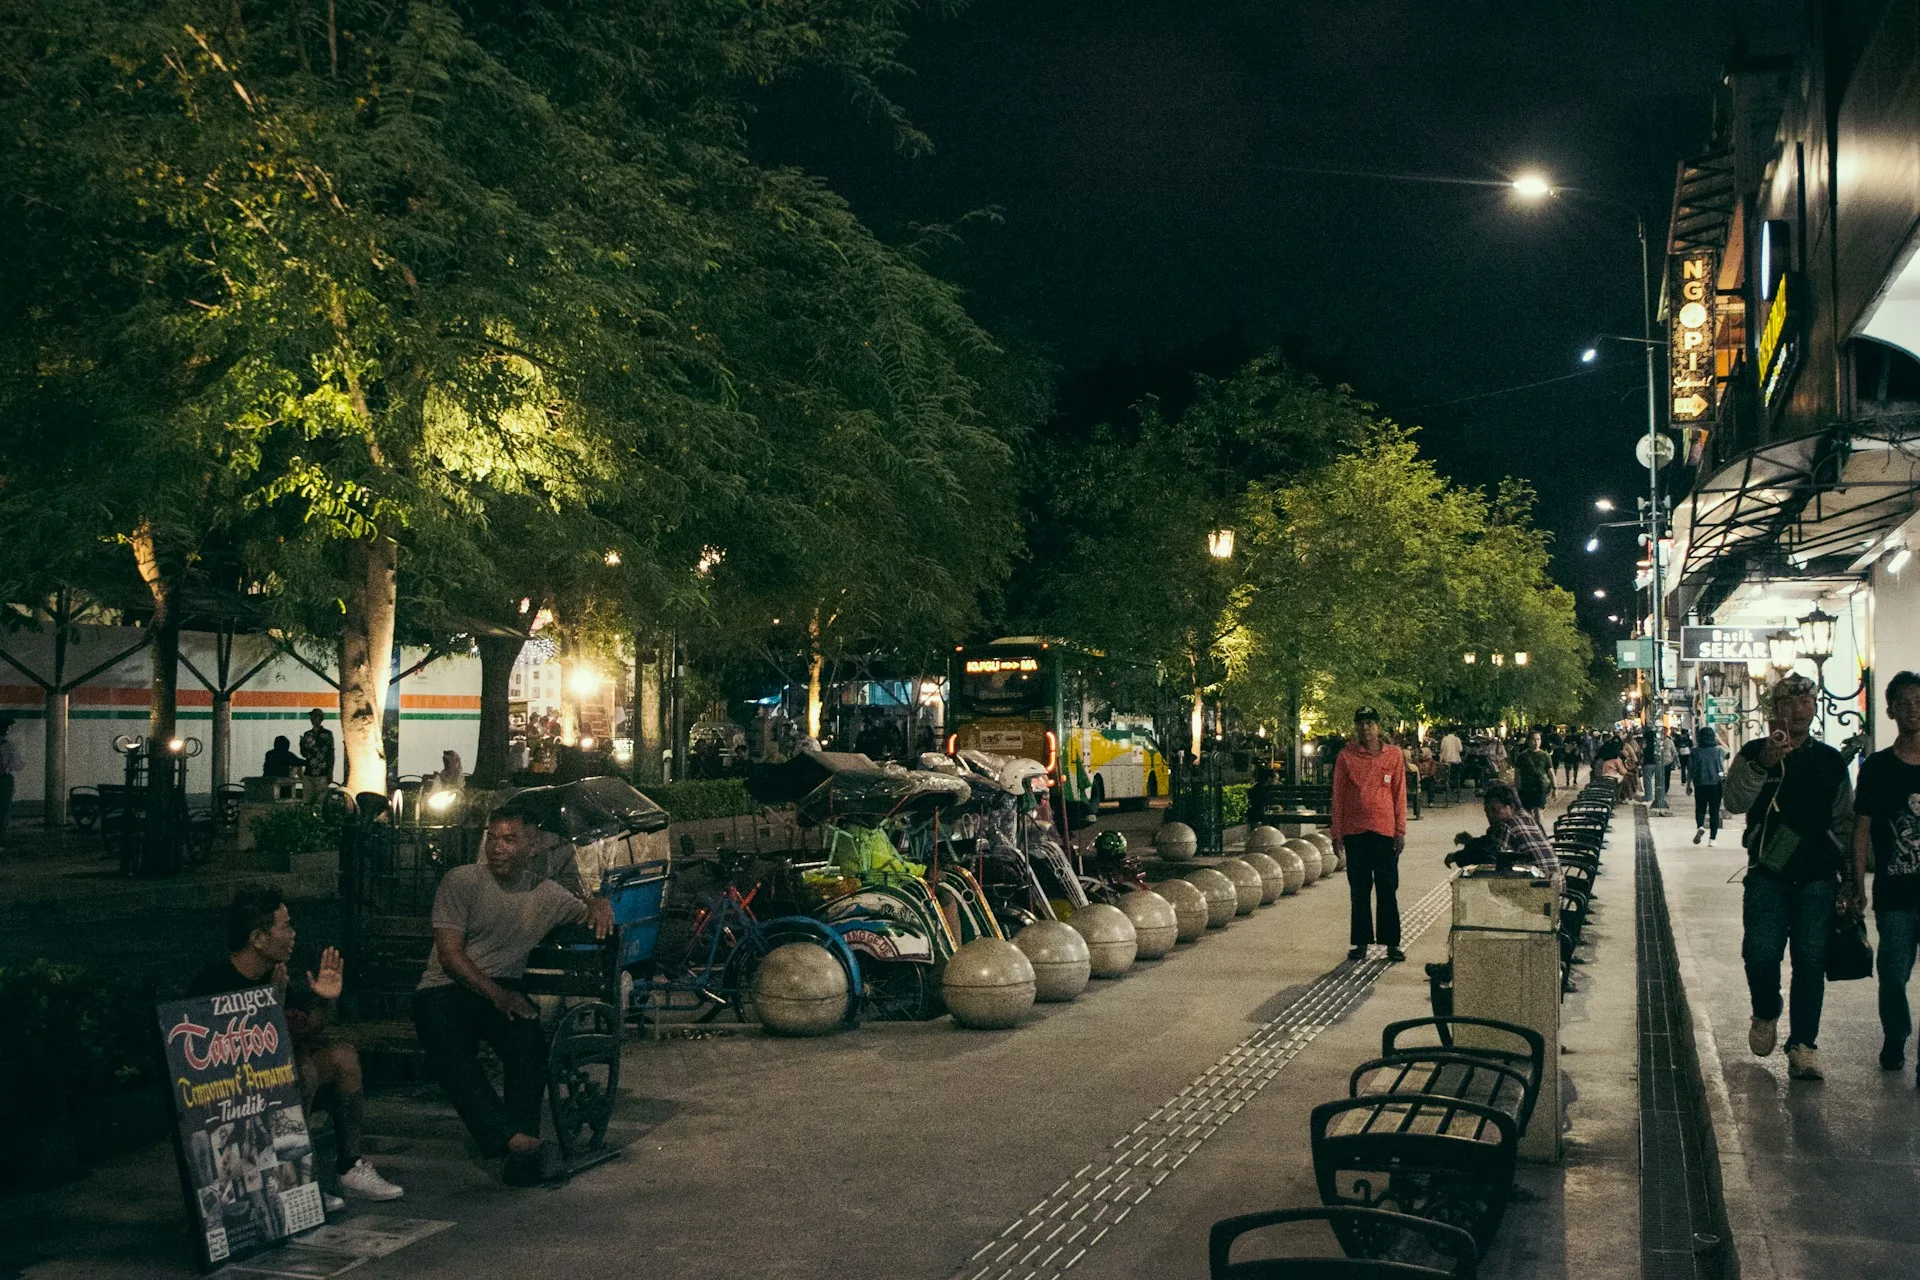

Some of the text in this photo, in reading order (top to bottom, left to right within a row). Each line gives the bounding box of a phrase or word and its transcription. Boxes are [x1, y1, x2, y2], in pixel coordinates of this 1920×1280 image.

[1712, 629, 1754, 642] Batik
[1699, 641, 1768, 658] SEKAR
[168, 1013, 279, 1071] Tattoo
[217, 1093, 267, 1122] Tindik
